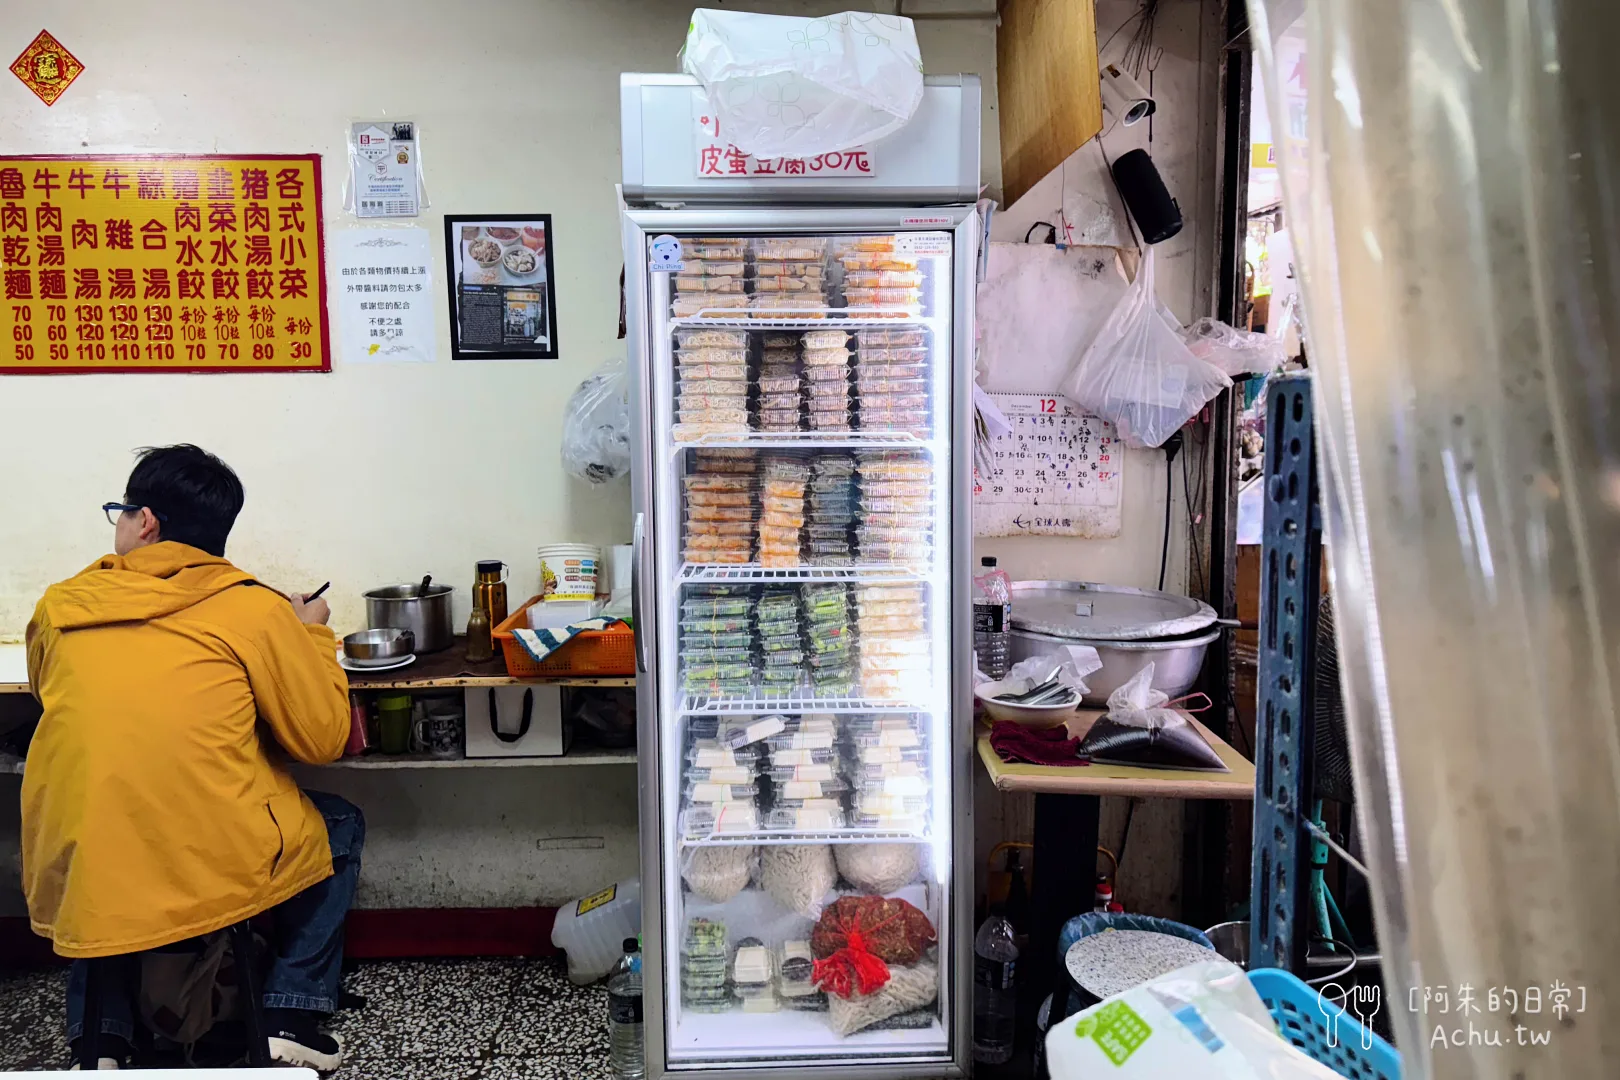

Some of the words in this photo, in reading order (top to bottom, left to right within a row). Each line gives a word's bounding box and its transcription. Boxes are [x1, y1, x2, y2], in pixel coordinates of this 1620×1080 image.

[33, 168, 68, 300] 牛肉湯麵
[67, 168, 102, 300] 牛肉湯
[103, 168, 136, 300] 牛雜湯
[275, 168, 308, 300] 各式小菜
[342, 266, 426, 276] 由於各類物價持續上漲
[12, 305, 31, 322] 70
[47, 305, 66, 322] 70
[75, 305, 103, 322] 130
[109, 305, 138, 322] 130
[144, 305, 172, 322] 130
[247, 305, 276, 323] 每份
[360, 301, 411, 310] 感謝您的配合
[179, 306, 208, 324] 每份
[212, 306, 241, 324] 每份
[368, 317, 402, 325] 不便之處
[13, 324, 32, 341] 60
[48, 324, 67, 341] 60
[76, 324, 104, 341] 120
[110, 324, 139, 341] 120
[145, 324, 173, 341] 120
[180, 324, 207, 341] 10粒
[214, 324, 240, 341] 10粒
[249, 323, 276, 340] 10粒
[284, 317, 313, 335] 每份
[15, 344, 34, 360] 50
[50, 344, 69, 360] 50
[76, 343, 105, 360] 110
[111, 343, 140, 360] 110
[145, 343, 174, 360] 110
[185, 344, 206, 360] 70
[218, 344, 239, 360] 70
[252, 343, 274, 360] 80
[290, 341, 312, 359] 30
[1040, 399, 1057, 412] 12
